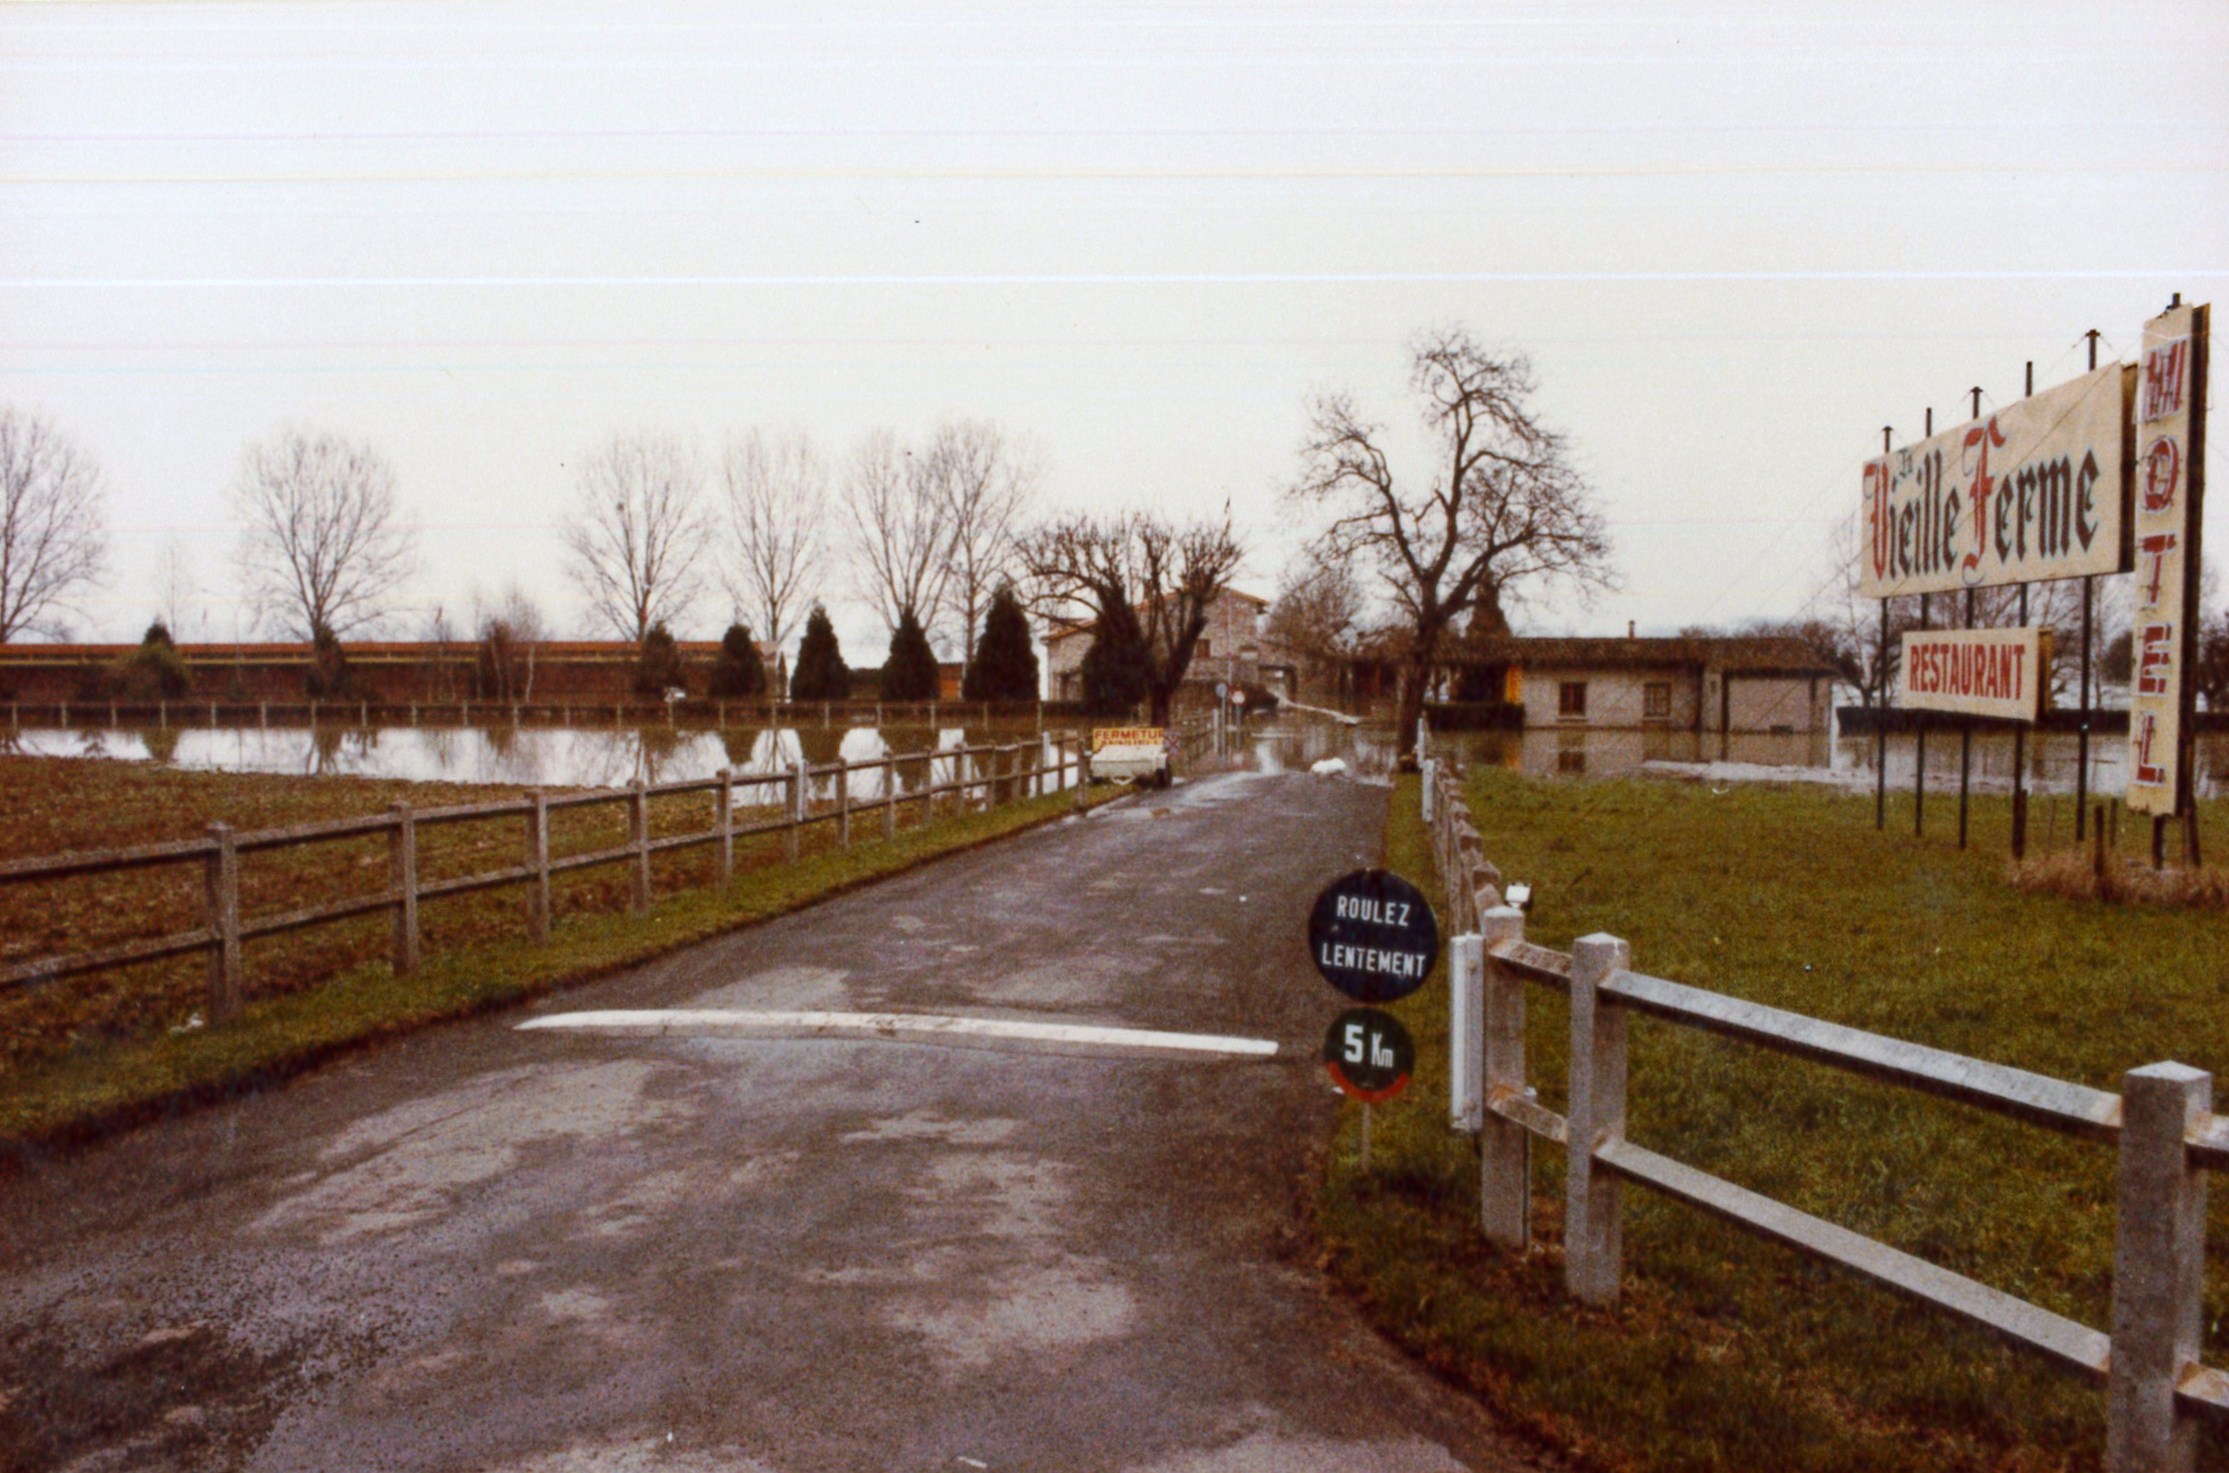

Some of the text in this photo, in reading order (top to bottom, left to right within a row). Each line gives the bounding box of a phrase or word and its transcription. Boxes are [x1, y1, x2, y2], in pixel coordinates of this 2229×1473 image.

[1862, 414, 2100, 587] Vieille Ferme
[2137, 338, 2187, 786] MOTEL
[1909, 642, 2026, 700] RESTAURANT
[1094, 729, 1165, 740] FERMETUR
[1336, 895, 1411, 927] ROULEZ
[1321, 942, 1426, 979] LENTEMENT
[1344, 1023, 1364, 1064] 5
